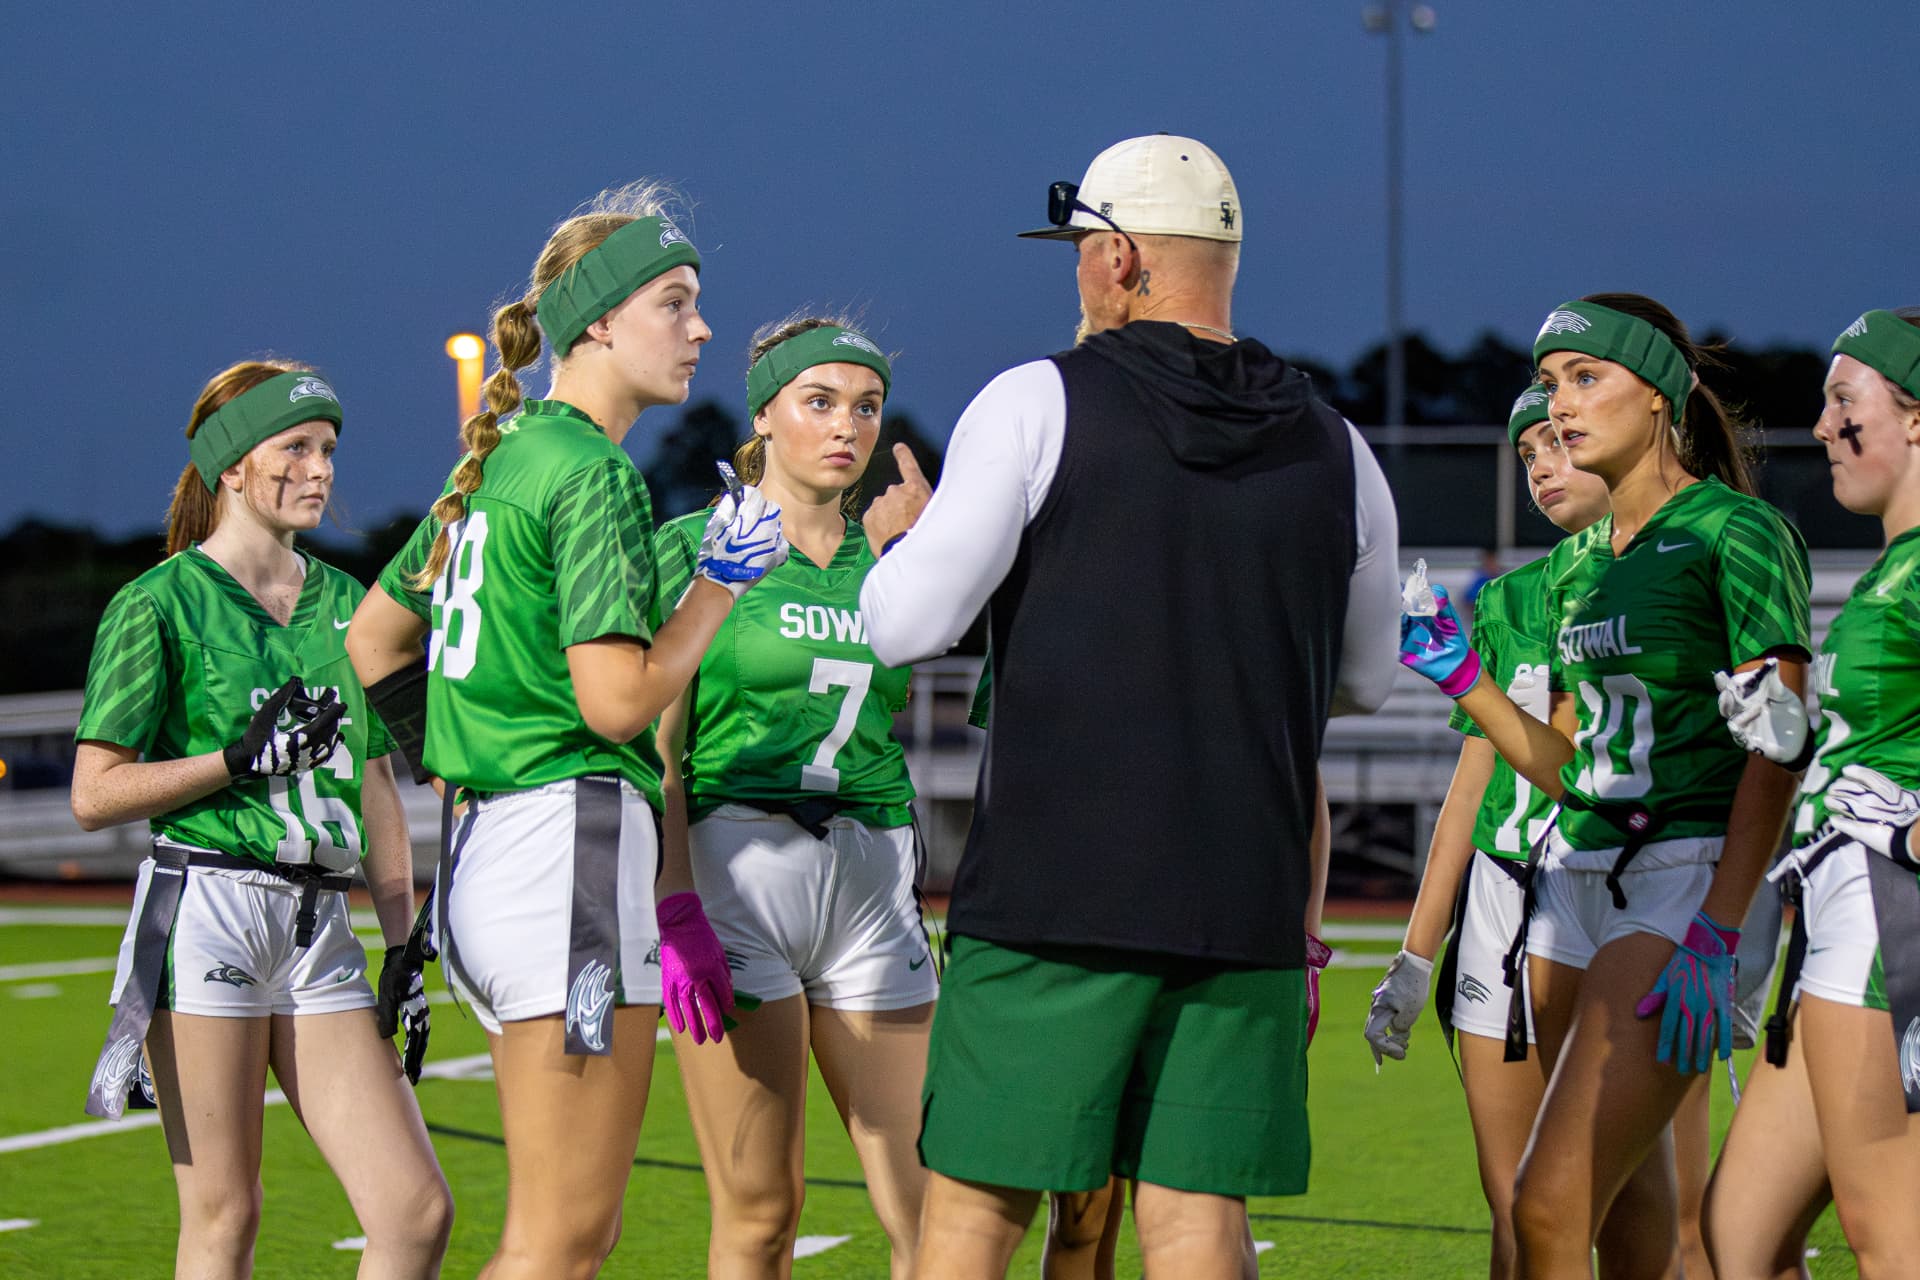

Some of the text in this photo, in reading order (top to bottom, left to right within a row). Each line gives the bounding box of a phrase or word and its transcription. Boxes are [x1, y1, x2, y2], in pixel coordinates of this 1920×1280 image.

[779, 602, 868, 645] SOW
[1557, 615, 1643, 665] SOWAL
[800, 657, 874, 793] 7
